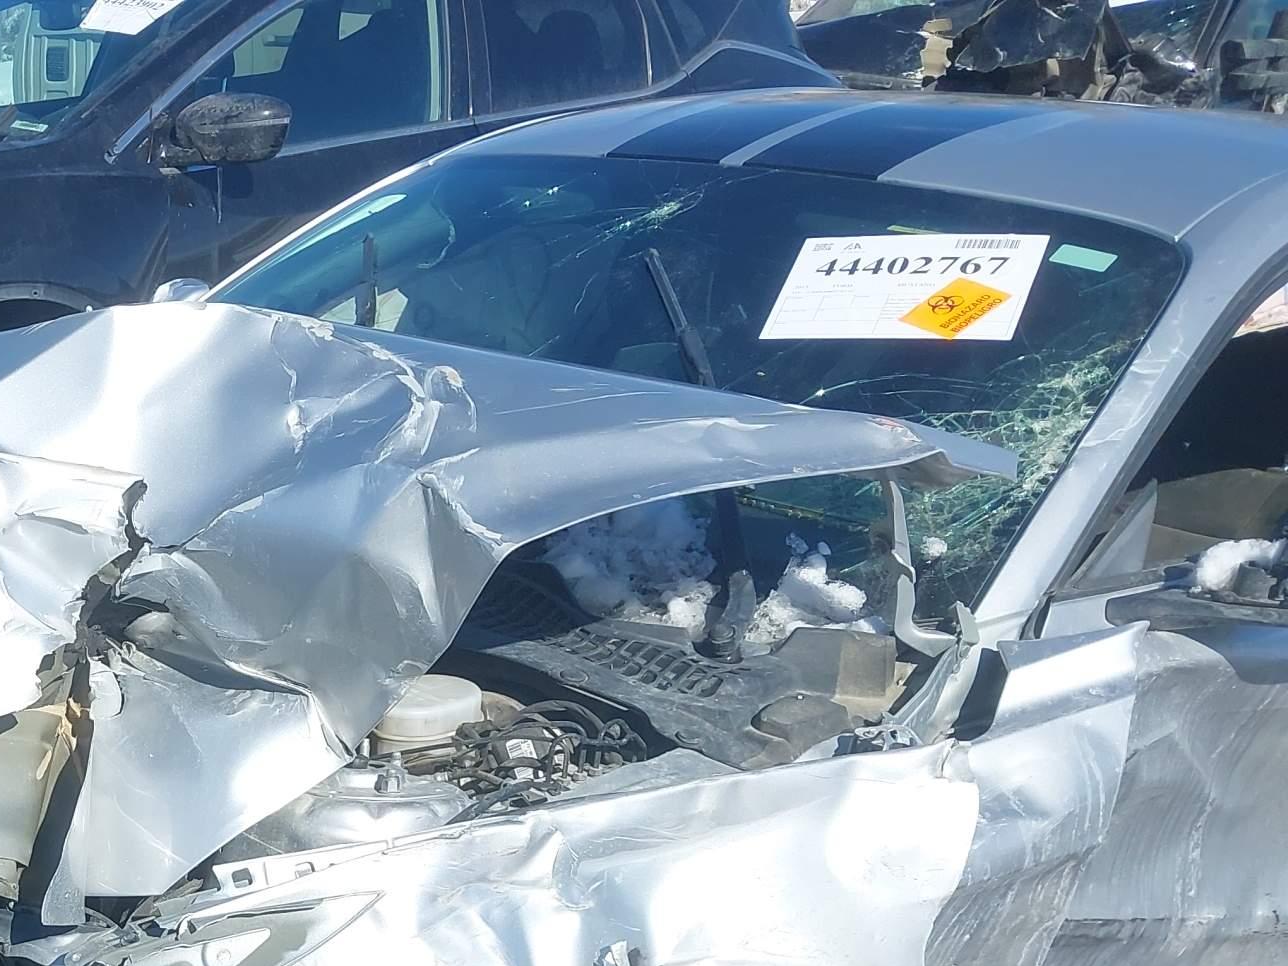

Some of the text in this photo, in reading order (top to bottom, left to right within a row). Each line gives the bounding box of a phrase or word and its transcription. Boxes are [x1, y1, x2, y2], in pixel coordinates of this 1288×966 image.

[816, 257, 1010, 276] 44402767
[940, 294, 991, 329] BIOHAZARD
[949, 298, 1003, 333] BIOPELIGRO
